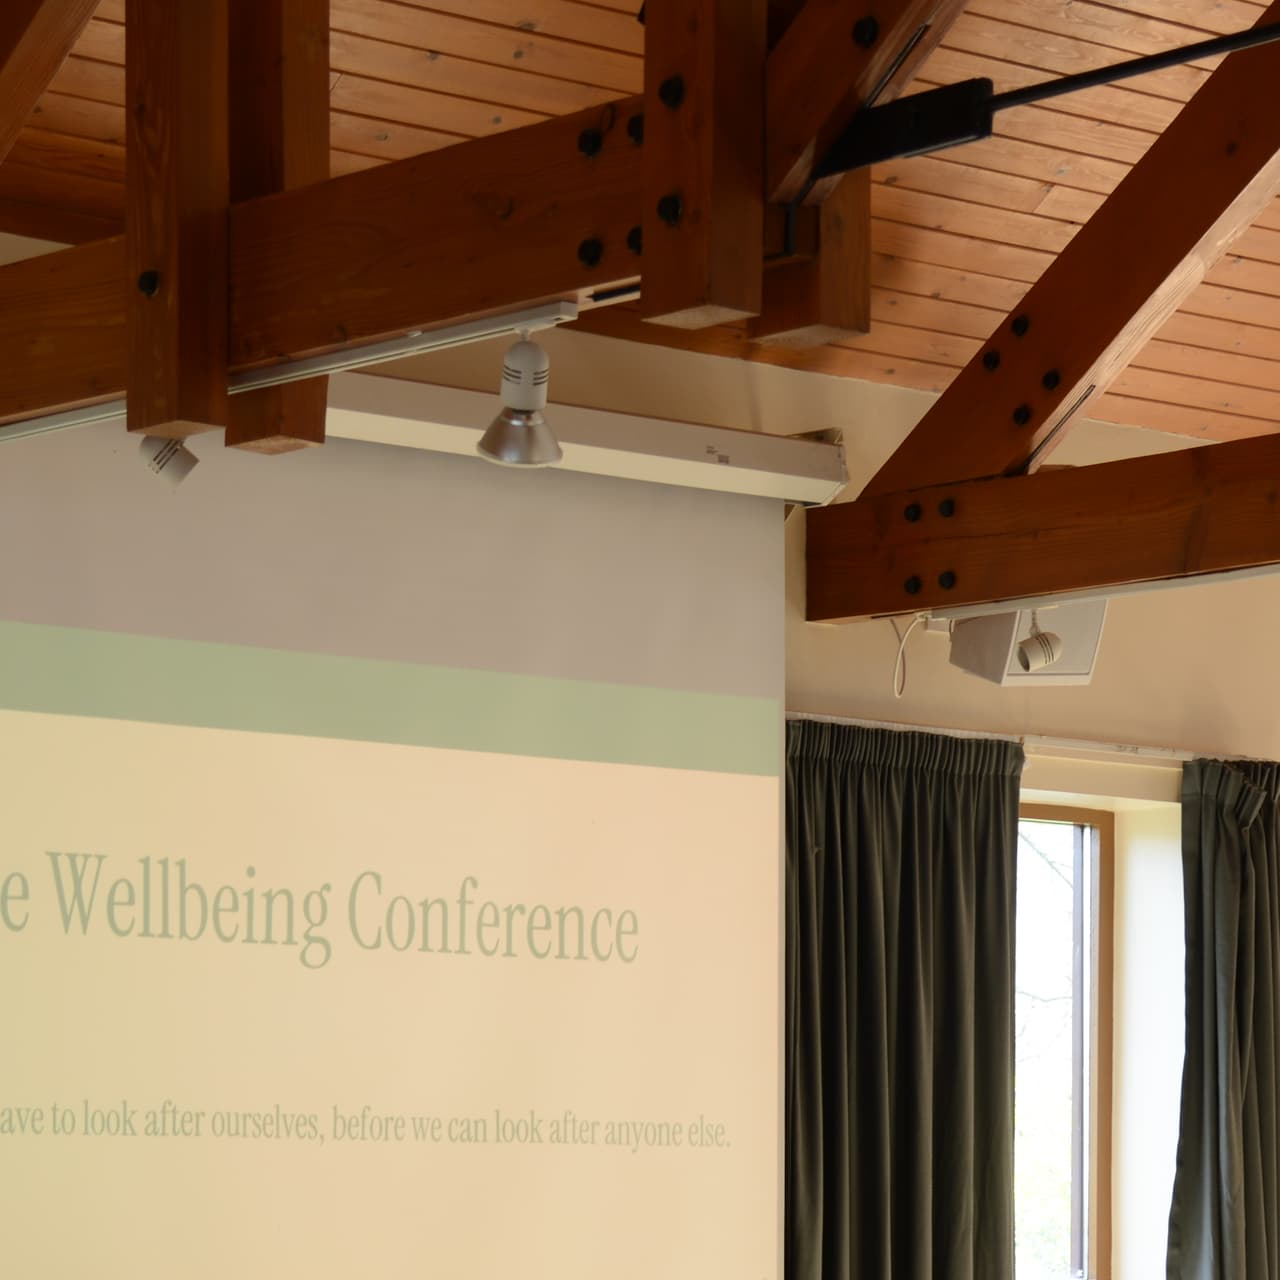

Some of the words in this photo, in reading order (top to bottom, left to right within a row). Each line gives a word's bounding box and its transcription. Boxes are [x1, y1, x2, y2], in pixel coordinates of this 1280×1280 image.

[45, 851, 332, 969] Wellbeing
[348, 871, 638, 963] Conference
[51, 1103, 76, 1135] to
[83, 1099, 138, 1136] look
[144, 1100, 205, 1136] after
[211, 1104, 324, 1145] ourselves,
[333, 1104, 405, 1141] before
[411, 1117, 442, 1142] we
[448, 1118, 488, 1143] can
[495, 1109, 543, 1143] look
[549, 1110, 600, 1144] after
[605, 1122, 683, 1153] anyone
[688, 1115, 730, 1147] else.
